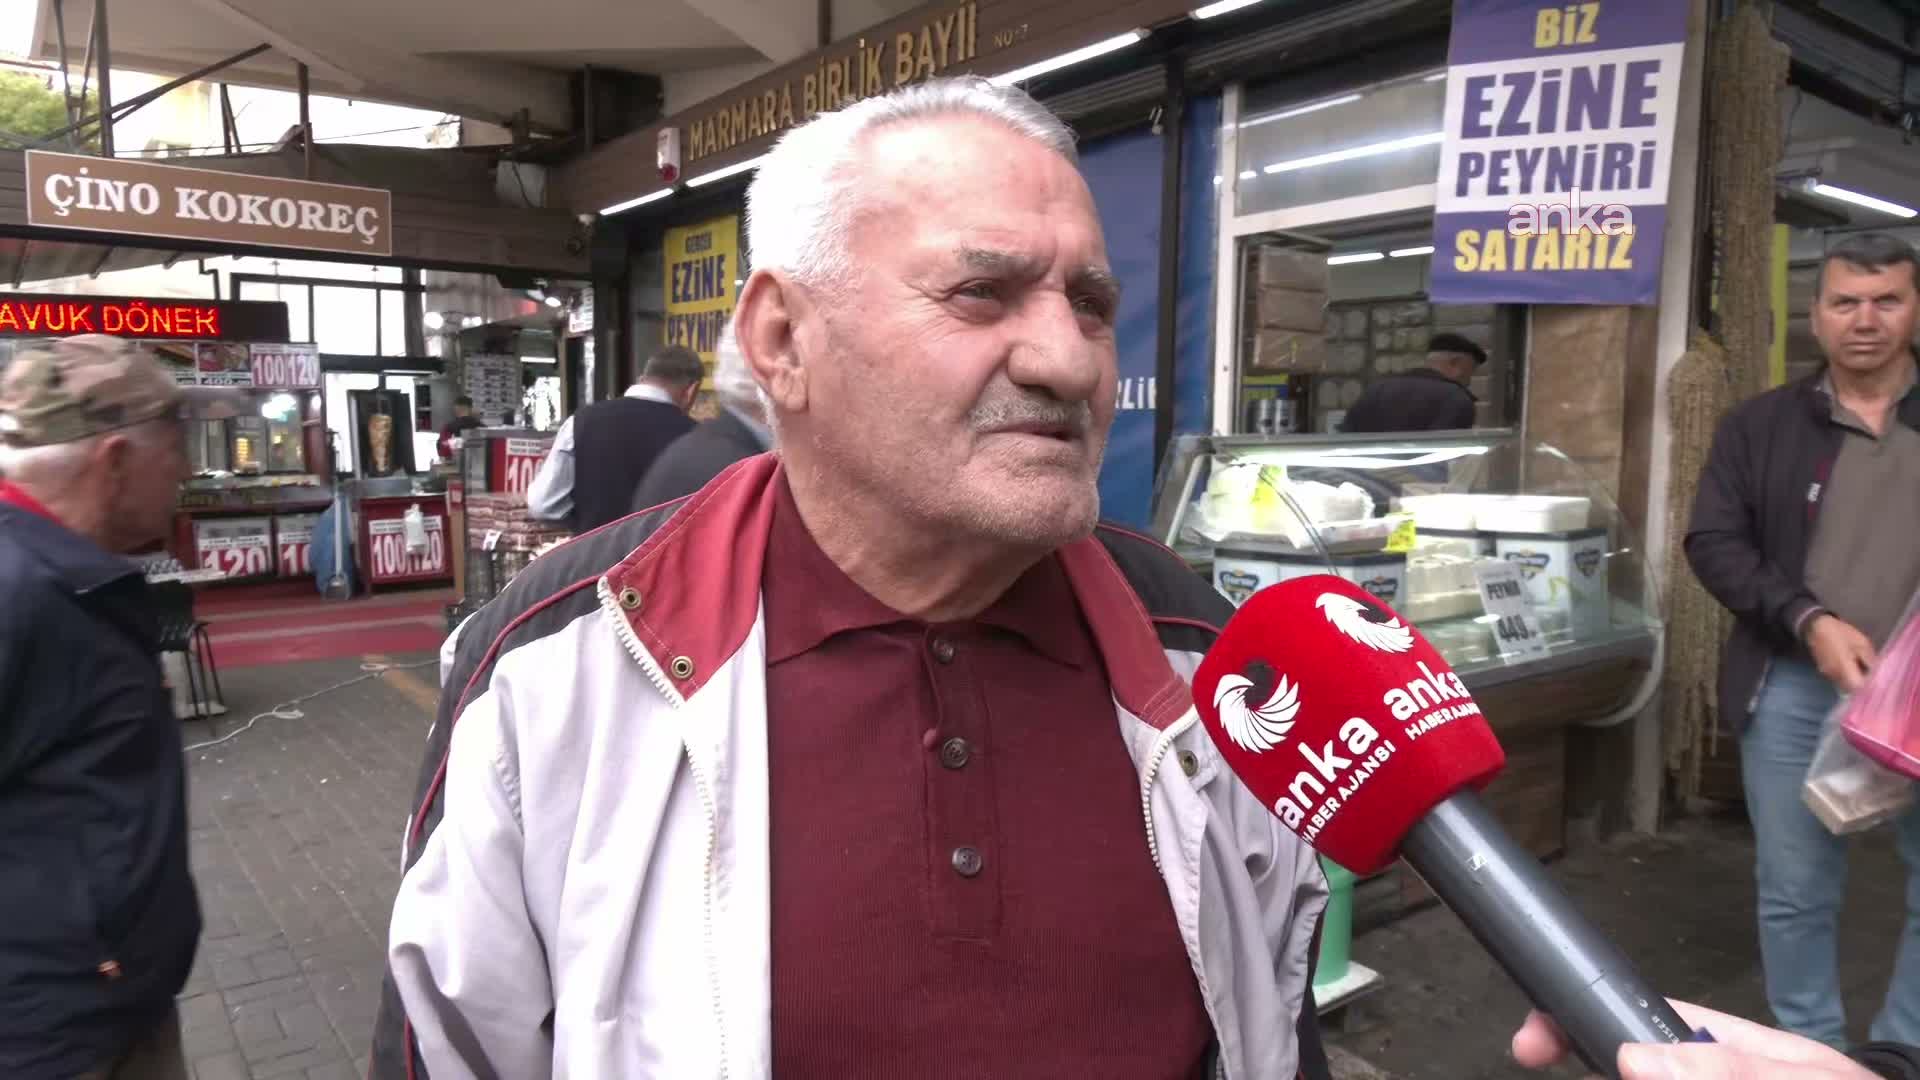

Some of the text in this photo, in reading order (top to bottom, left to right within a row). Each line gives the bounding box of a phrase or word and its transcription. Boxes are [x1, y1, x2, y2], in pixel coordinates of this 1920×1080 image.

[689, 84, 795, 162] MARMARA
[802, 38, 885, 118] BİRLİK
[44, 167, 380, 244] ÇİNO KOKOREÇ
[102, 300, 219, 335] DÖNER
[253, 354, 318, 386] 100 120
[1383, 660, 1472, 721] anka
[1404, 708, 1455, 741] HABER
[1274, 717, 1380, 830] anka
[1301, 739, 1397, 845] HABER AJANSI
